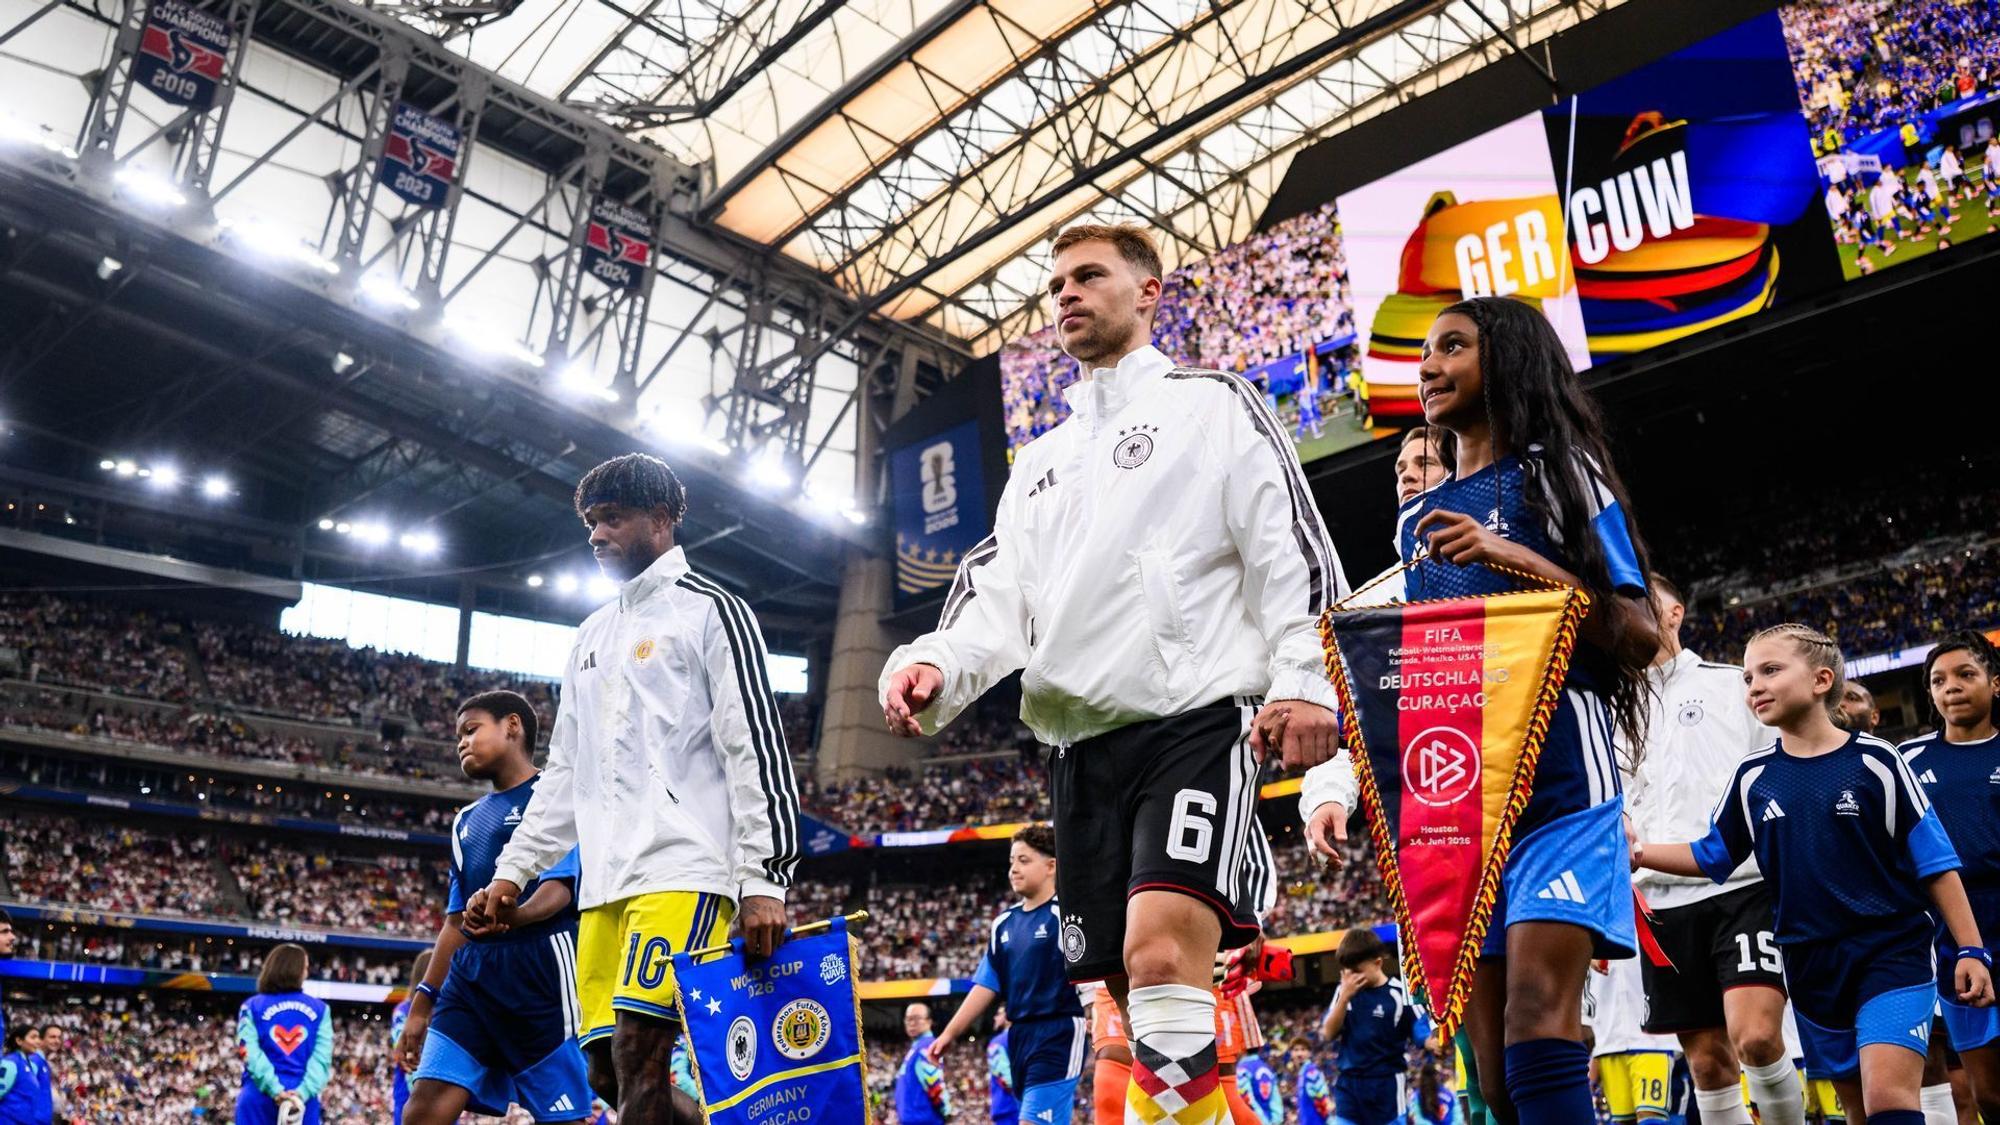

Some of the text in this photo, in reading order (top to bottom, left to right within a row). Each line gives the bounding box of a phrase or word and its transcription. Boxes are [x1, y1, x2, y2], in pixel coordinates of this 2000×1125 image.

[153, 5, 229, 47] CHAMPIONS
[187, 10, 225, 32] SOUTH
[152, 68, 197, 100] 2019
[394, 172, 433, 201] 2023
[1455, 150, 1695, 300] GER CUW
[593, 258, 631, 285] 2024
[1425, 628, 1463, 643] FIFA
[1458, 652, 1475, 661] USA
[1379, 668, 1510, 690] DEUTSCHLAND
[1397, 692, 1488, 714] CURAÇAO
[340, 824, 409, 841] HOUSTON
[1166, 788, 1217, 864] 6
[1420, 825, 1459, 834] Houston
[1410, 836, 1471, 846] 14. Juni 2026
[247, 927, 327, 943] HOUSTON
[623, 932, 671, 989] 10
[1735, 931, 1783, 974] 15
[769, 960, 804, 978] CUP
[820, 957, 844, 972] BLUE
[820, 965, 847, 981] WAVE
[262, 1000, 318, 1021] VOLUNTEER
[1642, 1078, 1662, 1101] 18
[747, 1085, 808, 1120] GERMANY
